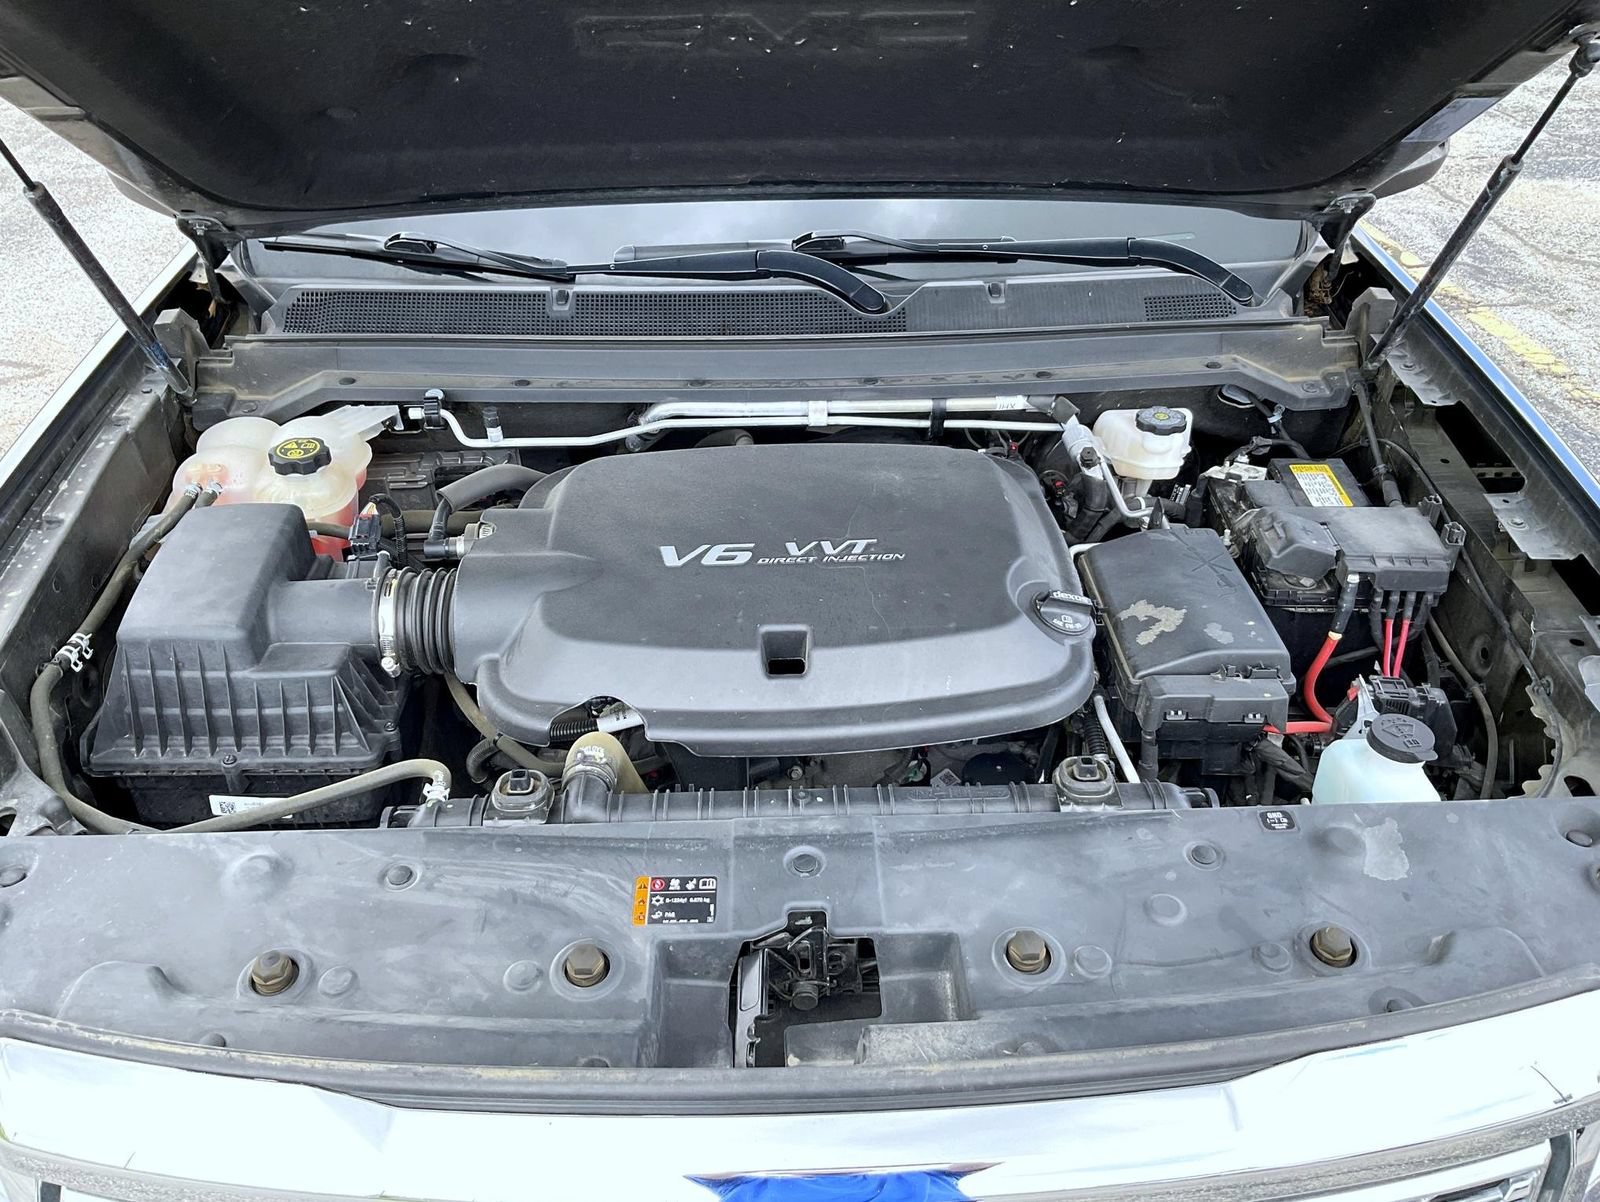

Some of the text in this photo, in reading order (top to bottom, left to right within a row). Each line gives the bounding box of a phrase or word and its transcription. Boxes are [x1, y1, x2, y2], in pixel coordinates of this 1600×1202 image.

[660, 539, 877, 567] V6 VVT
[757, 553, 906, 565] DIRECT INJECTION
